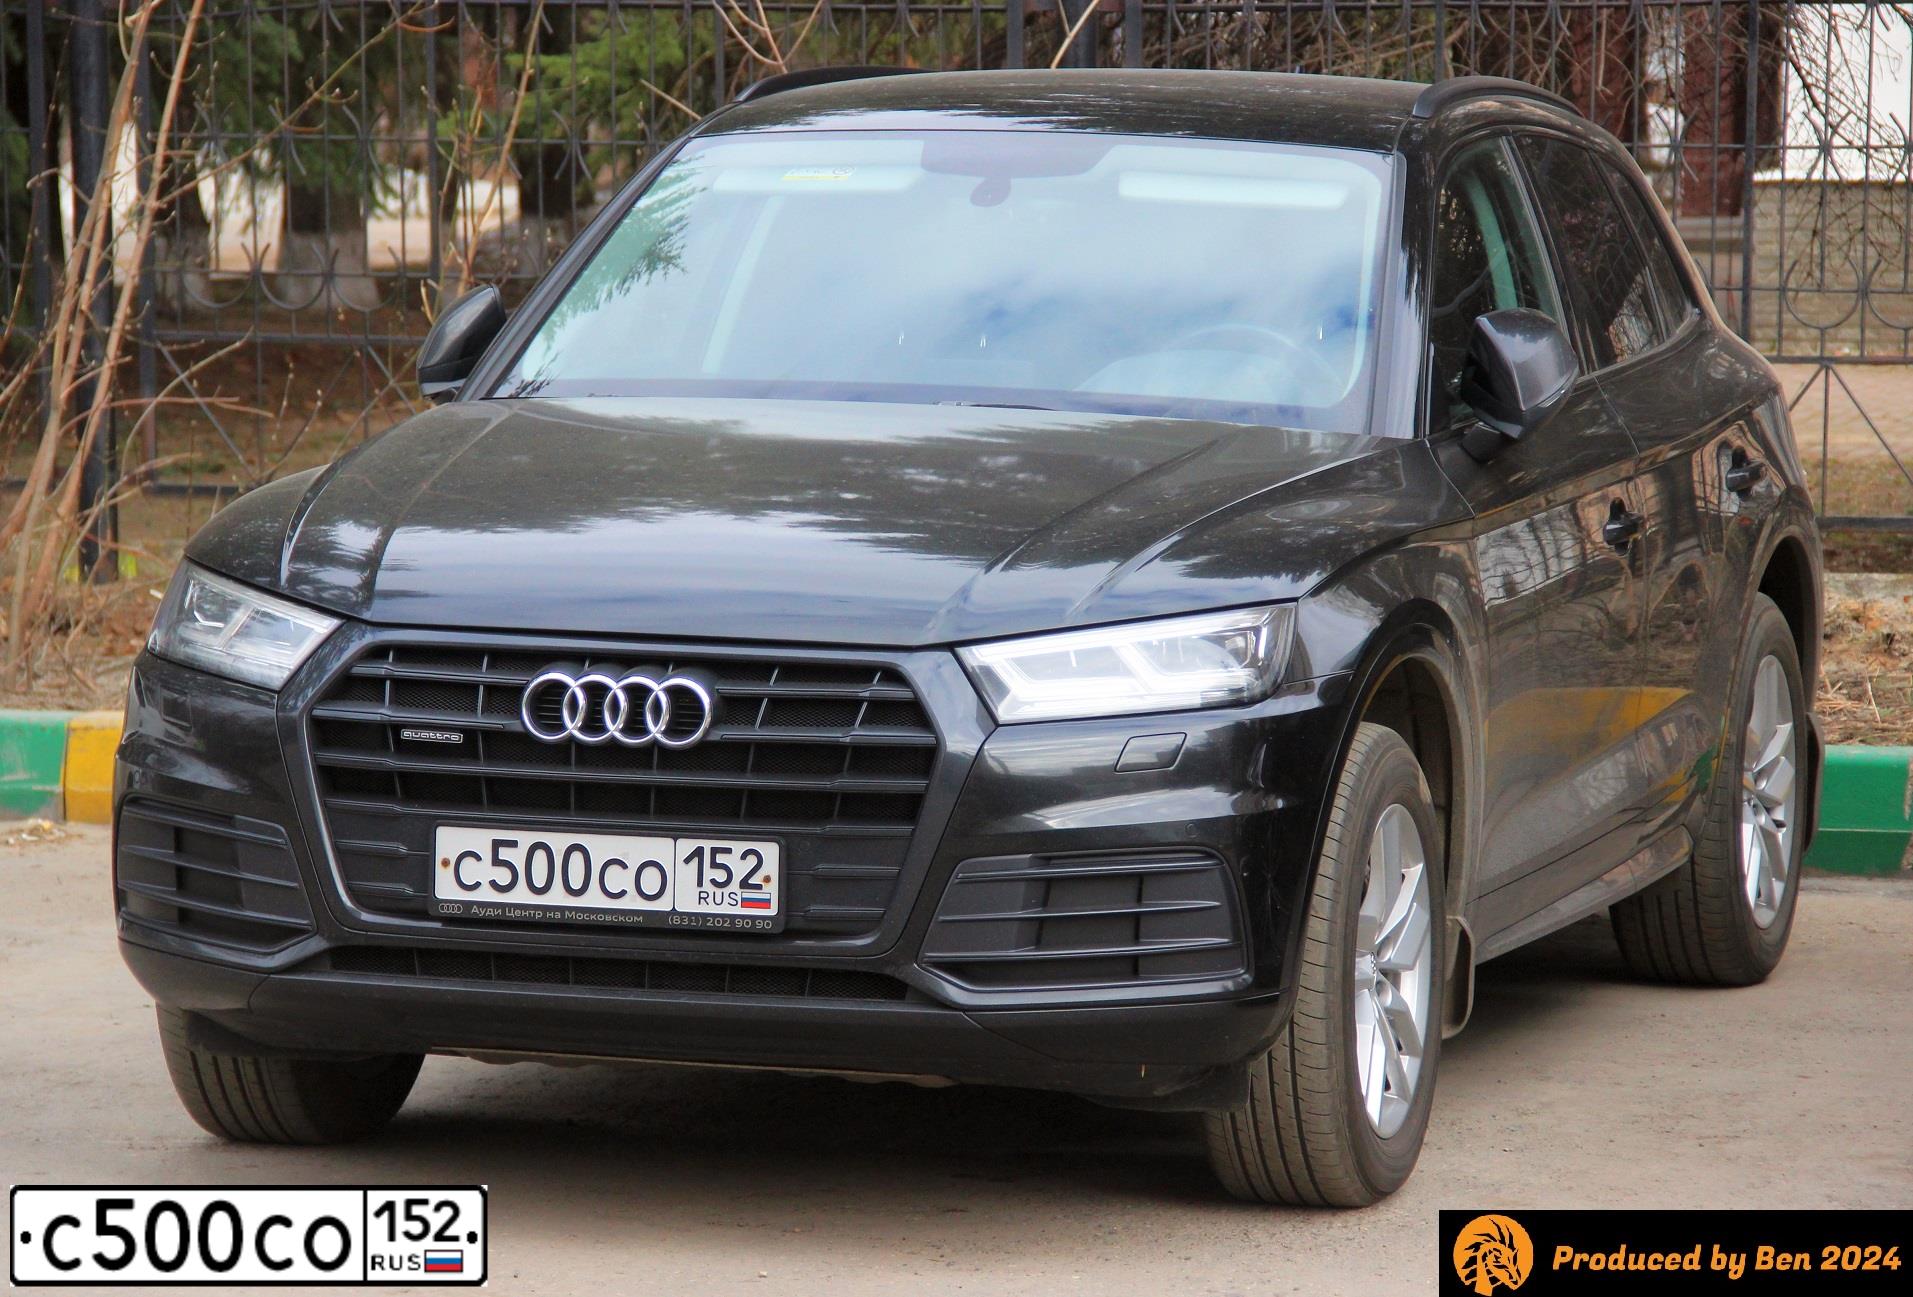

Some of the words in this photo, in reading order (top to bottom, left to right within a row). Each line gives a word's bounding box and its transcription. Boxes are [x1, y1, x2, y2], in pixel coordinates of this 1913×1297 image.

[403, 731, 460, 741] quattro
[682, 845, 764, 891] 152
[697, 890, 739, 907] RUS
[471, 905, 502, 917] Ауди
[505, 907, 543, 919] Центр
[546, 910, 561, 919] на
[564, 910, 643, 923] Московском
[668, 915, 702, 926] (831)
[706, 917, 731, 927] 202
[735, 918, 752, 928] 90
[755, 920, 772, 929] 90
